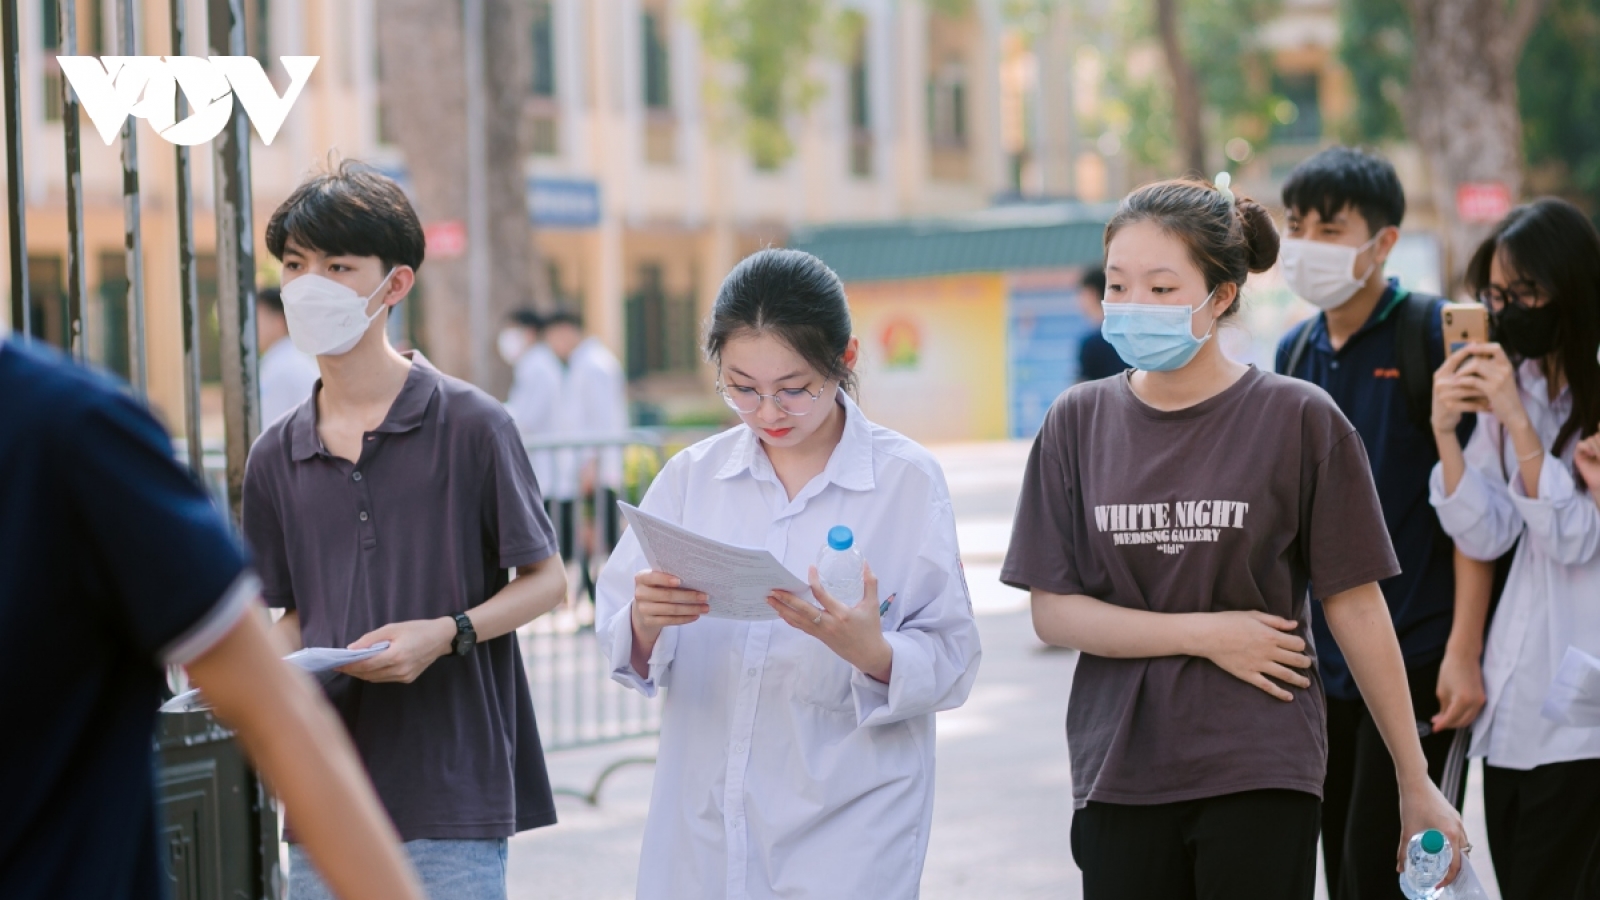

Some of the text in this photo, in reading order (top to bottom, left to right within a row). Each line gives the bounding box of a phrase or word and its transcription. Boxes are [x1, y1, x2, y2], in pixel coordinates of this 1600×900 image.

[1094, 500, 1249, 532] WHITE NIGHT
[1171, 528, 1221, 542] GALLERY
